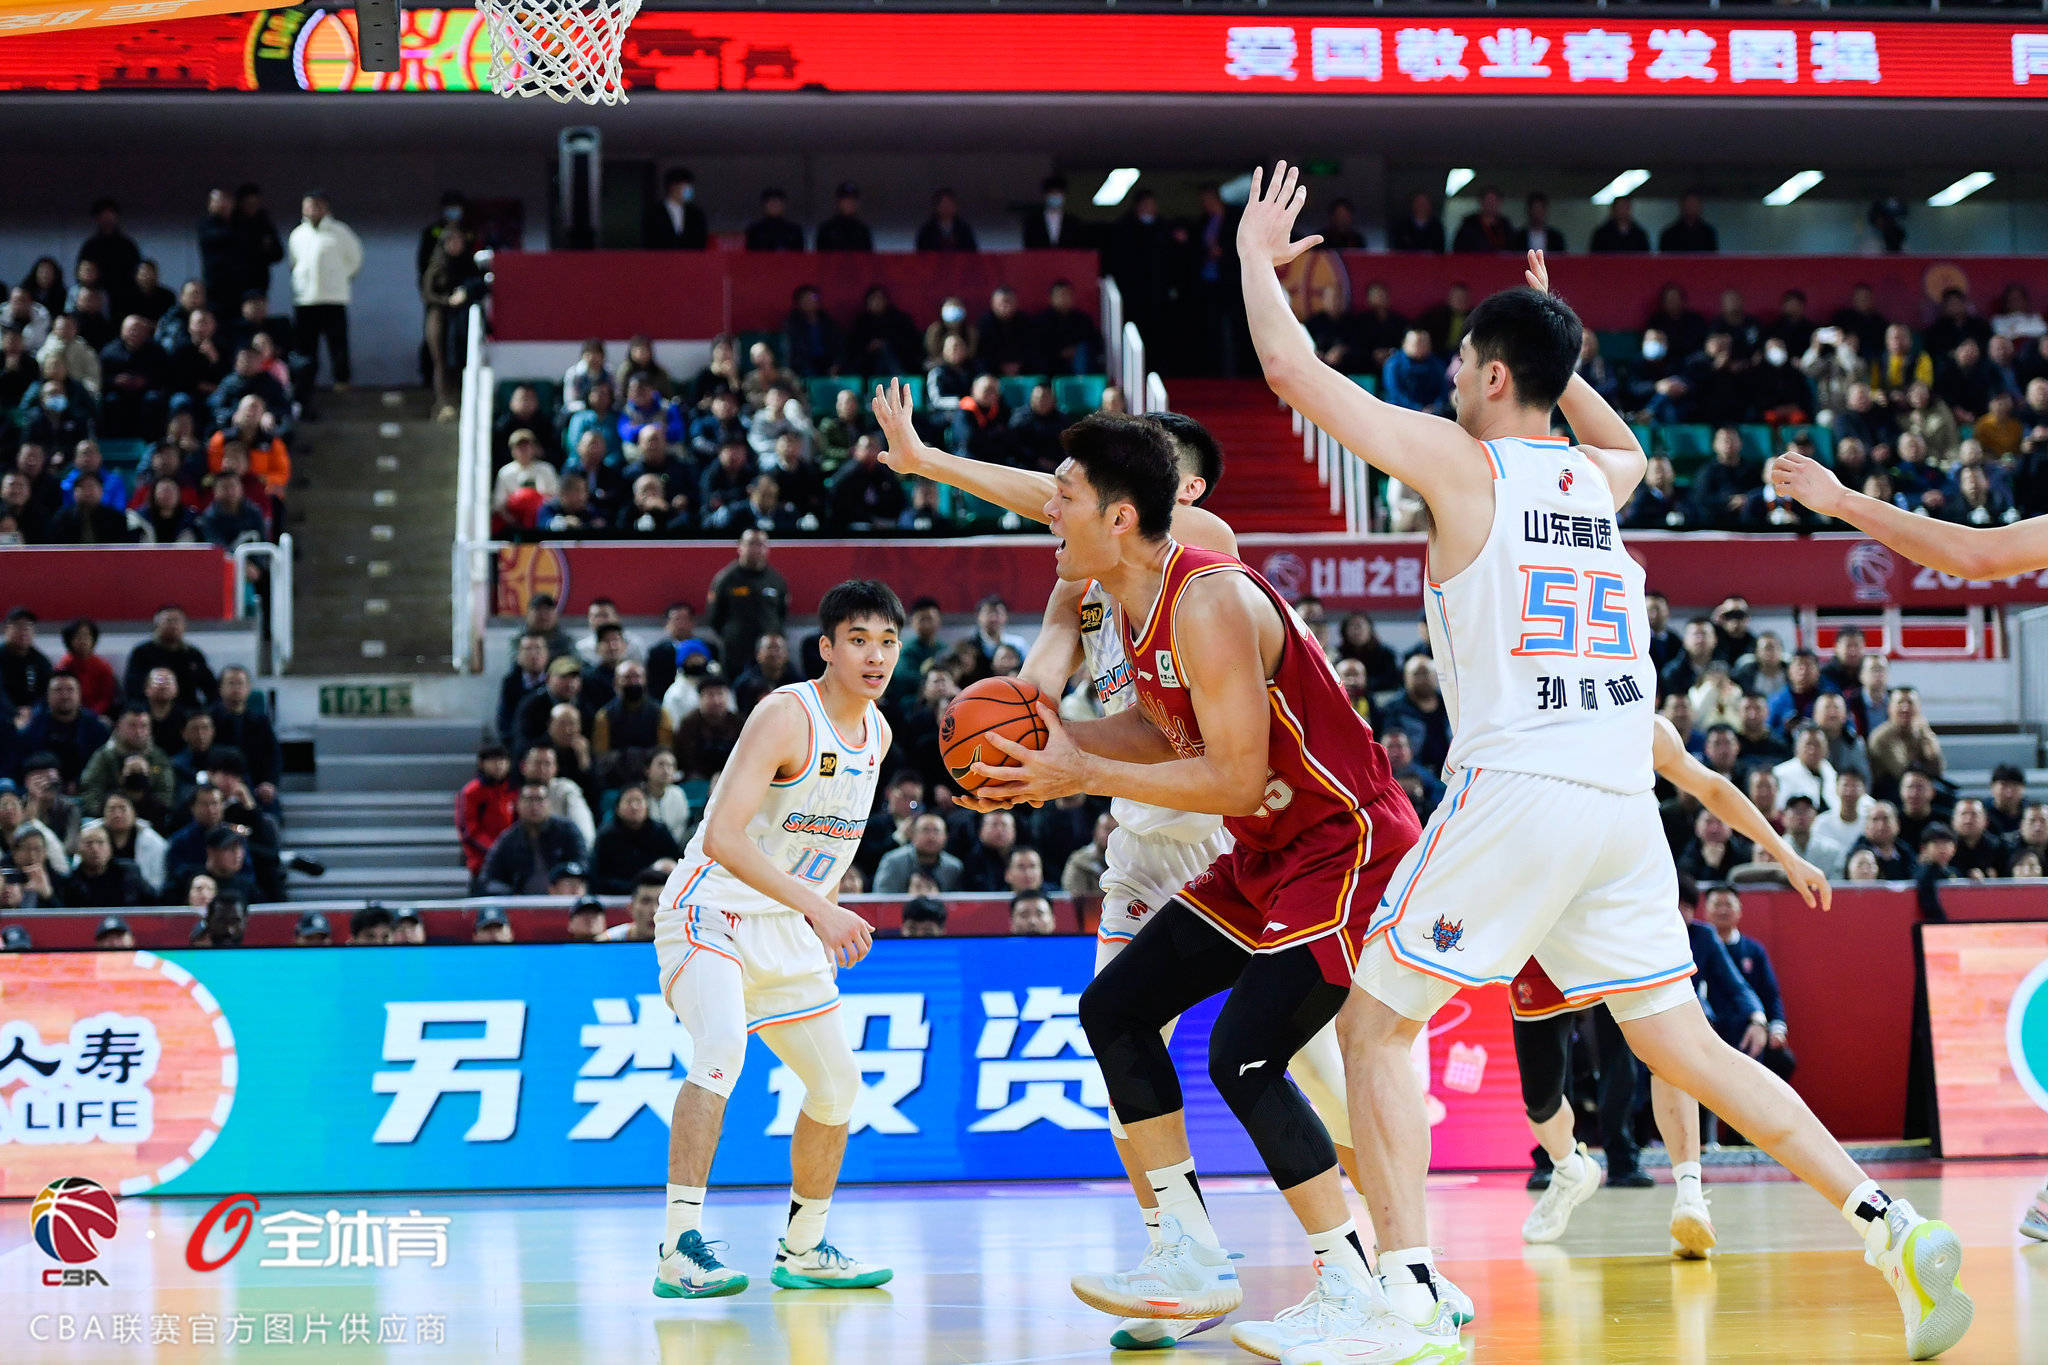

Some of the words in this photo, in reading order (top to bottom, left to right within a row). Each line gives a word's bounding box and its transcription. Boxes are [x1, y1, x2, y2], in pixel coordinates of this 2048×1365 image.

[1524, 509, 1612, 552] 山东高速
[1510, 564, 1638, 660] 55
[1536, 674, 1644, 712] 孙桐林
[785, 847, 839, 884] 10
[0, 1028, 144, 1083] 人寿
[26, 1100, 138, 1129] LIFE
